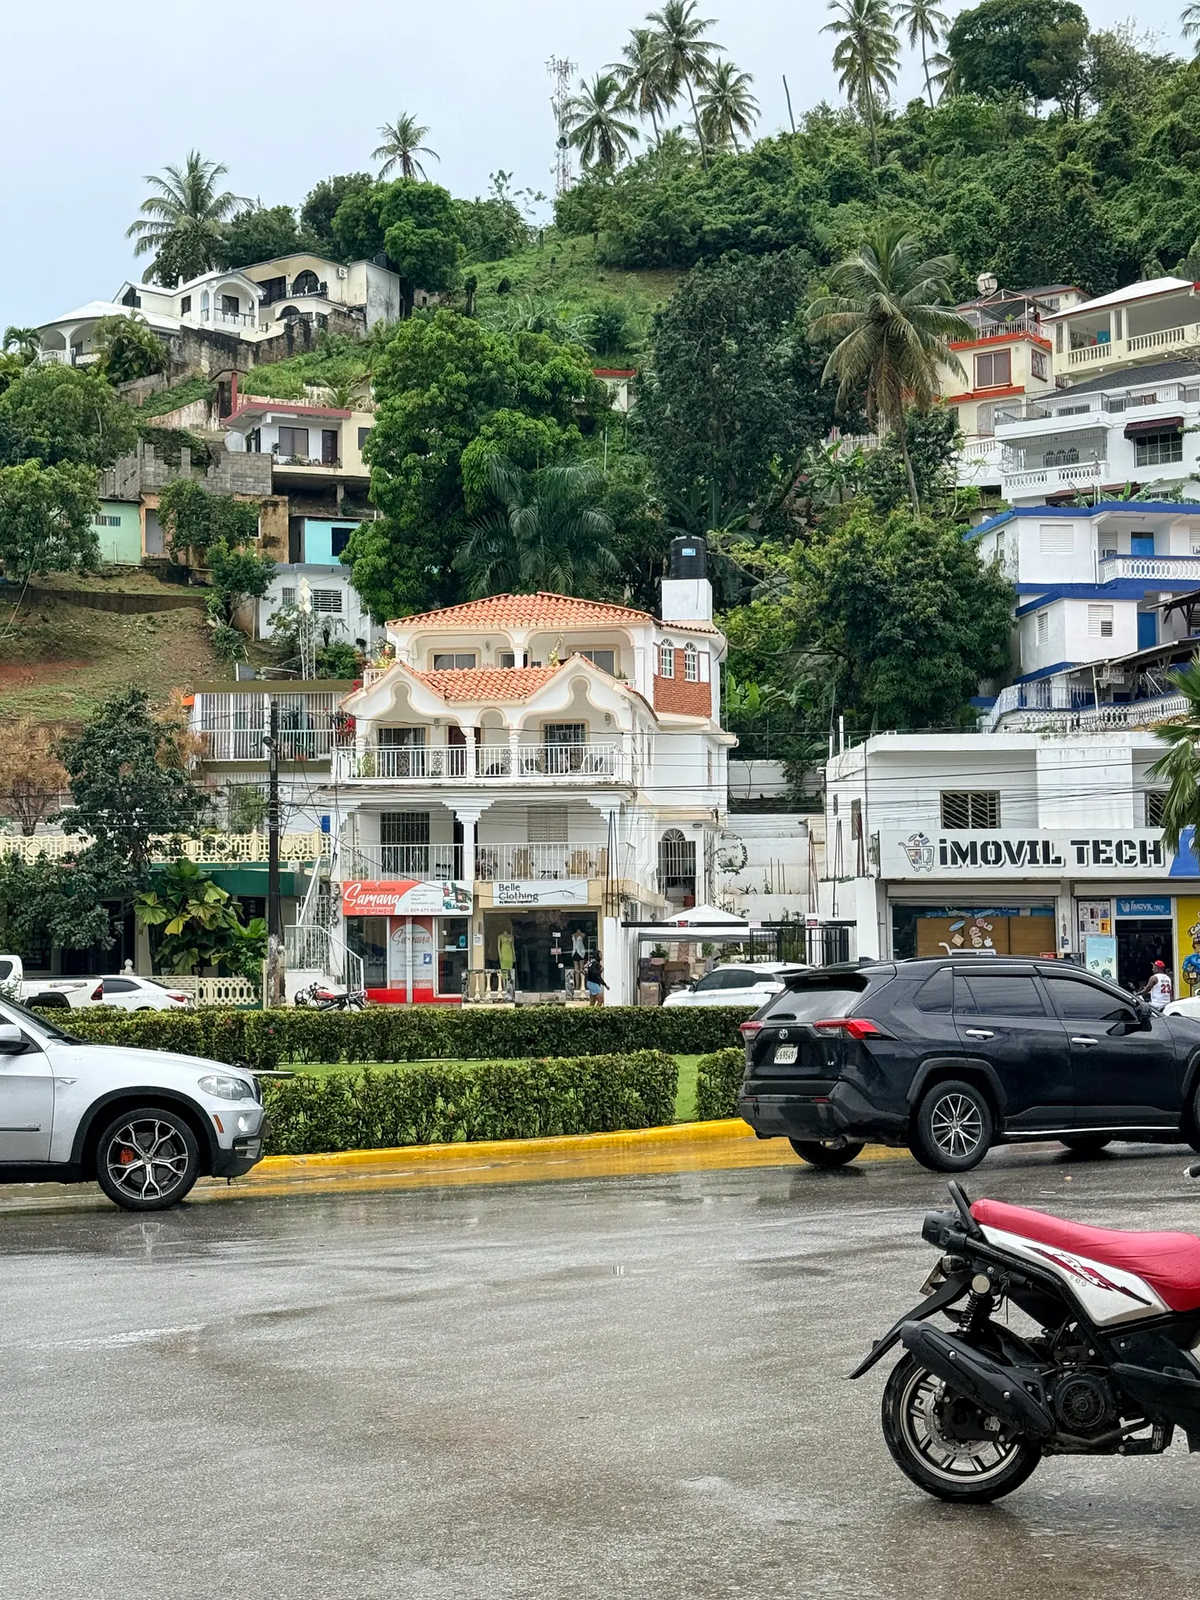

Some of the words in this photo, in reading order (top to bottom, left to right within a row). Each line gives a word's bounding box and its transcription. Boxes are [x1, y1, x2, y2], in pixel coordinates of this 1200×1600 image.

[938, 838, 1064, 867] iMOVIL
[1070, 839, 1164, 867] TECH
[498, 883, 521, 892] Belle
[498, 892, 540, 903] Clothing
[1160, 983, 1171, 994] 23
